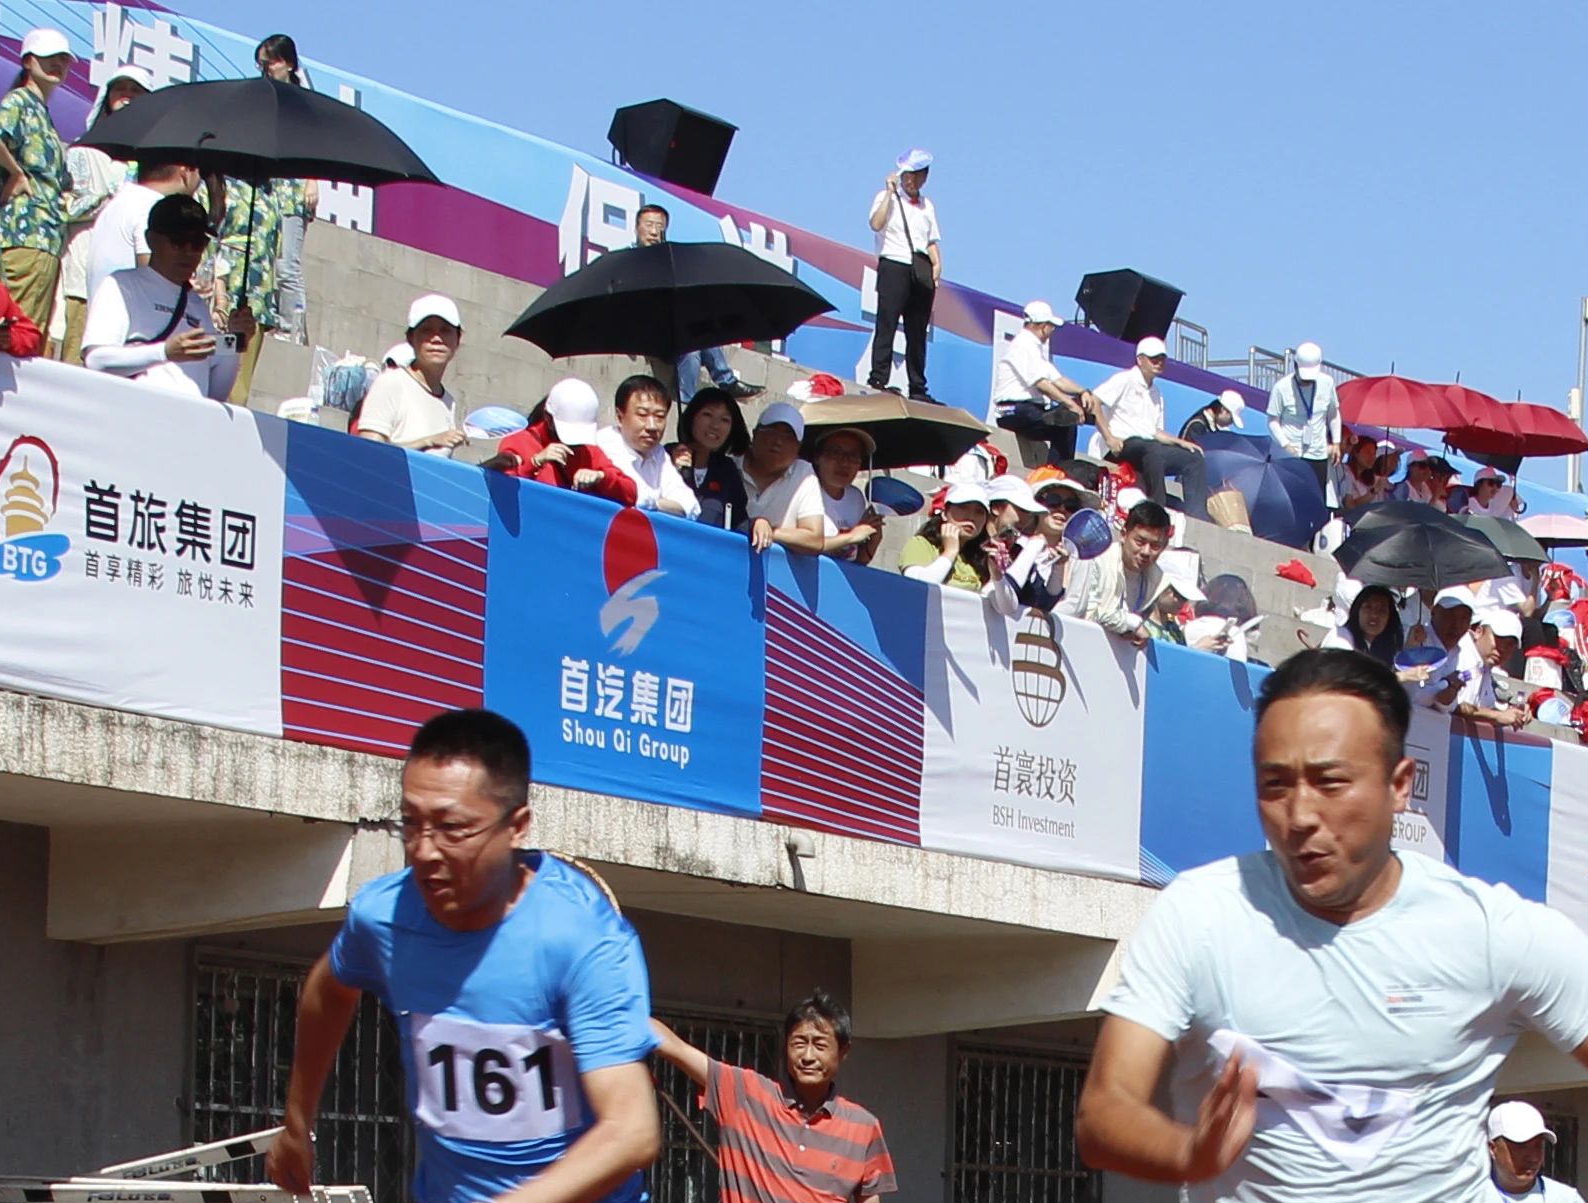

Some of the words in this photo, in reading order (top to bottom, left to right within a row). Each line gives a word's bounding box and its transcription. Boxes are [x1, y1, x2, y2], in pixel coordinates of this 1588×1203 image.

[83, 480, 257, 570] 首旅集团
[3, 544, 48, 577] BTG
[84, 550, 164, 590] 首享精彩
[177, 569, 255, 608] 旅悦未来
[561, 656, 694, 733] 首汽集团
[562, 718, 605, 747] Shou
[613, 729, 631, 753] Qi
[639, 736, 690, 769] Group
[993, 745, 1077, 806] 首寰投资
[992, 804, 1013, 828] BSH
[1018, 811, 1075, 839] Investment
[428, 1044, 556, 1115] 161
